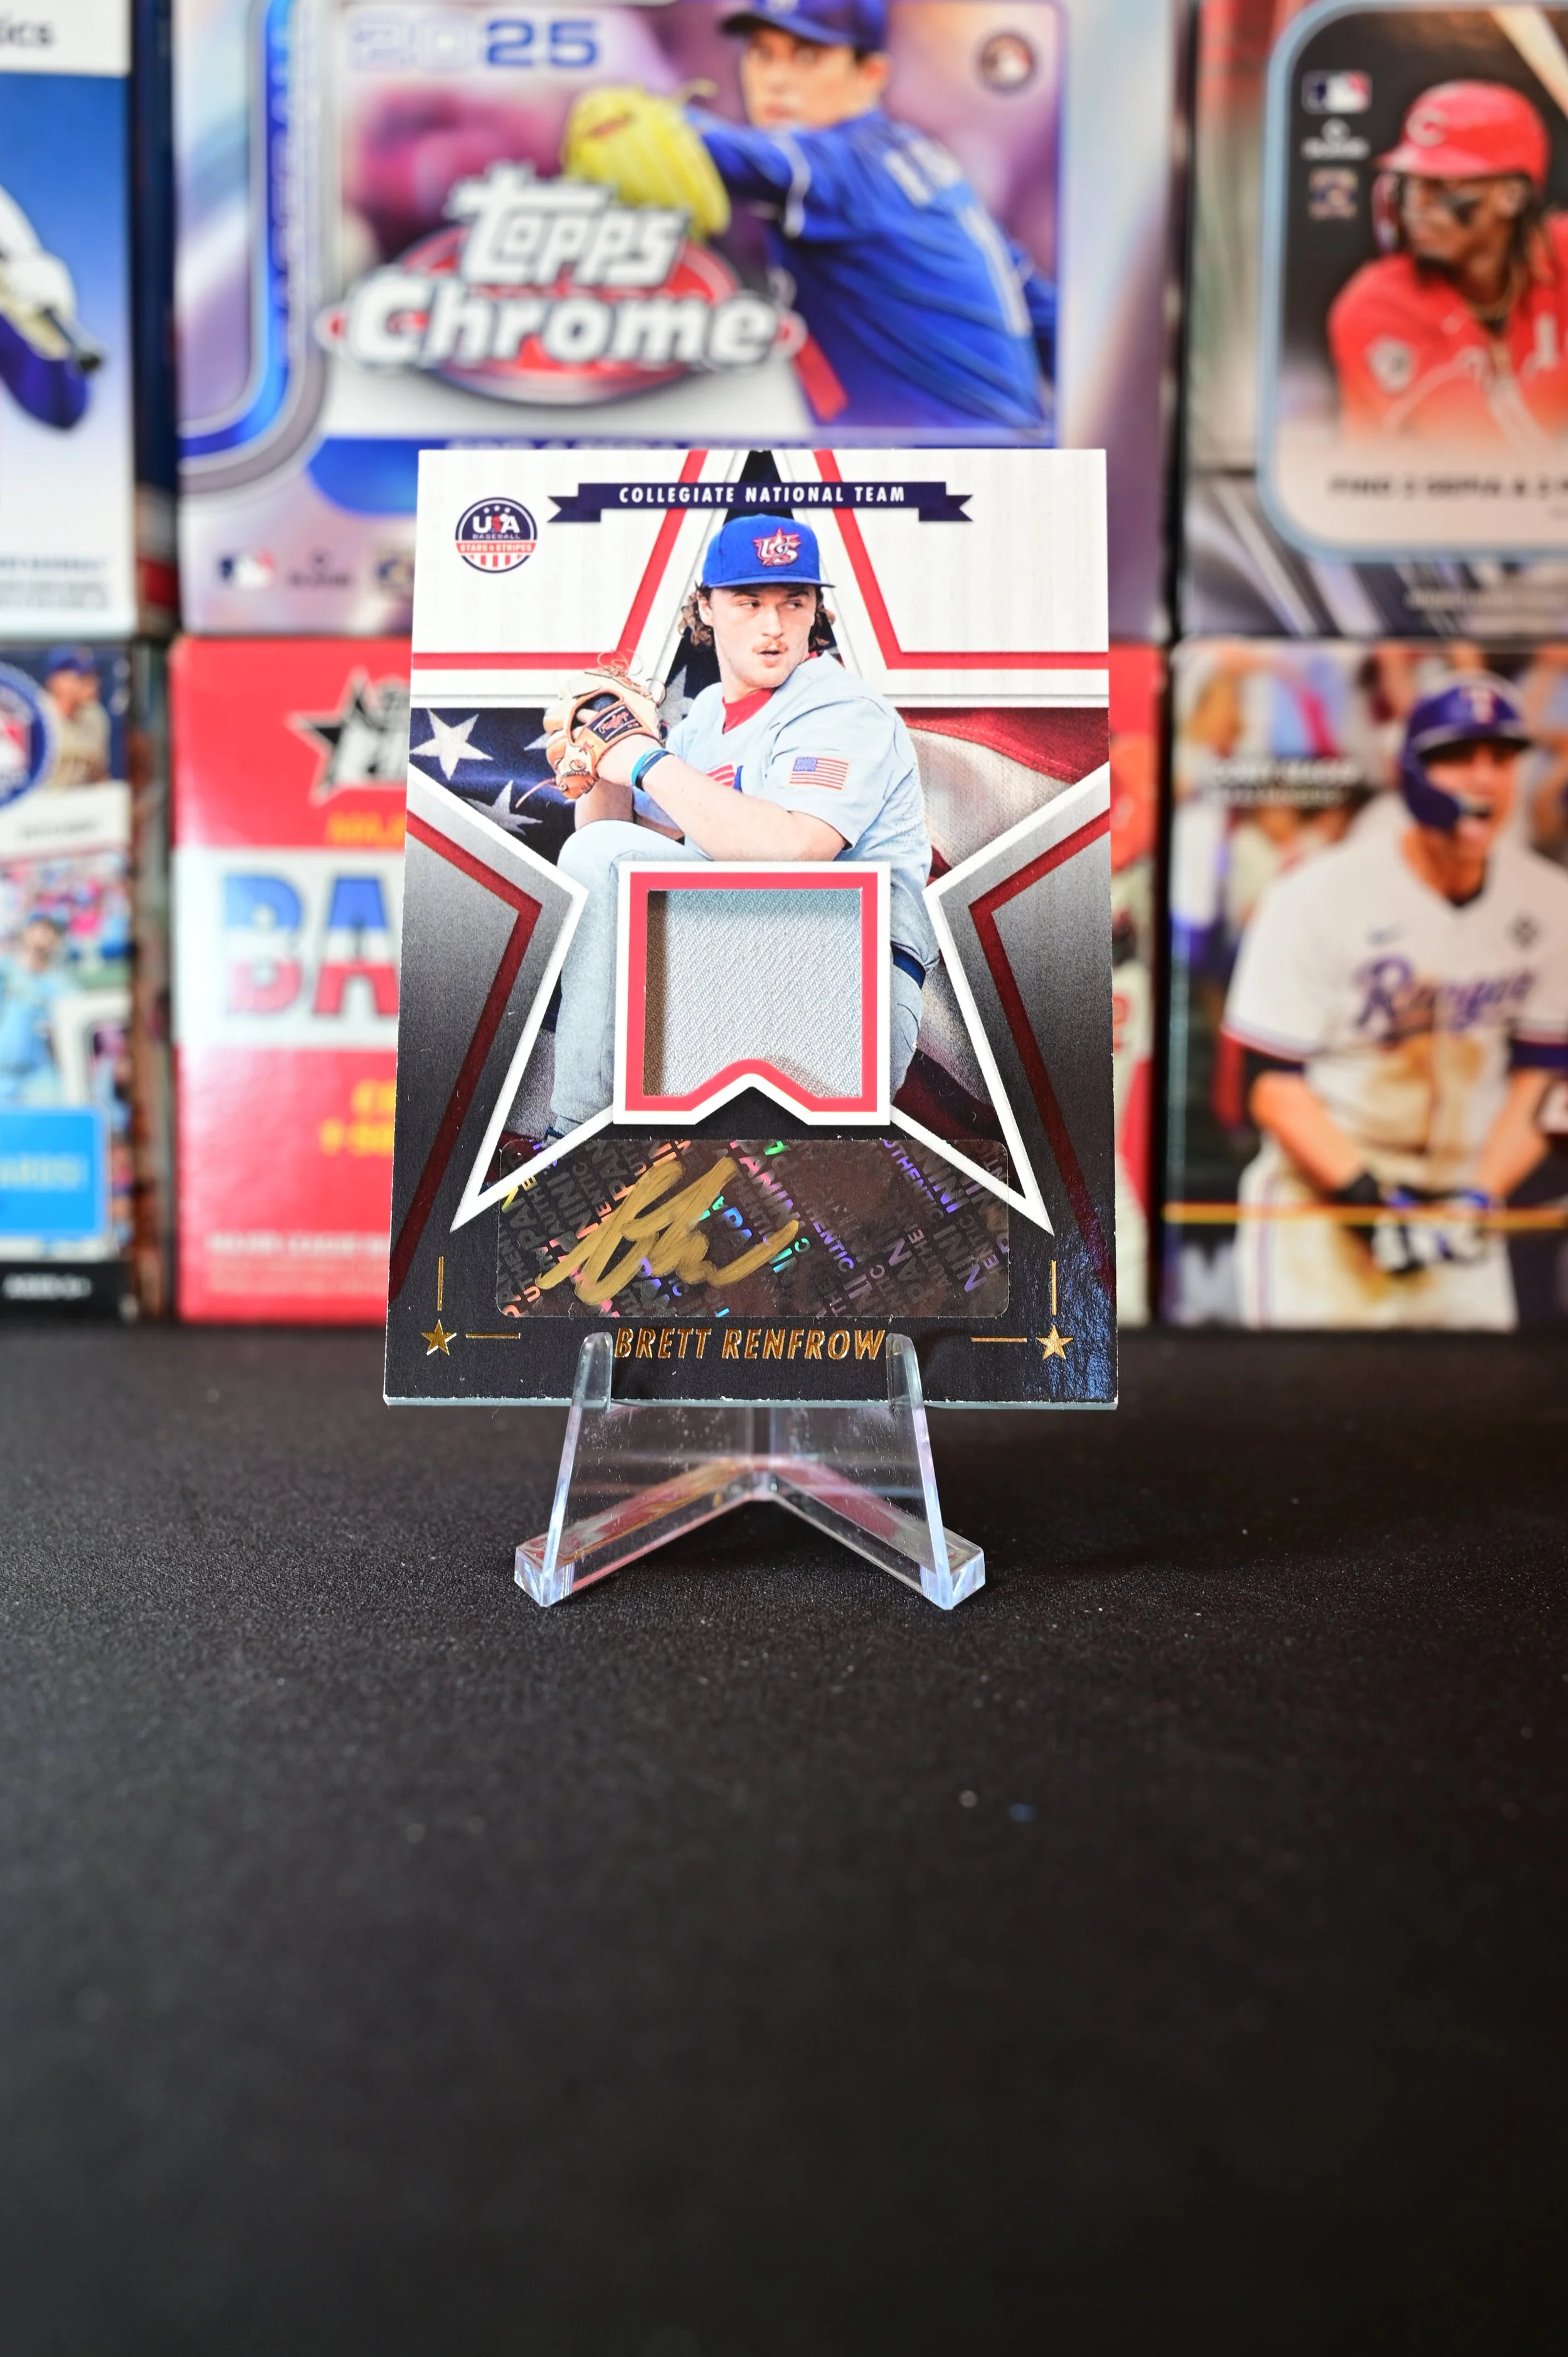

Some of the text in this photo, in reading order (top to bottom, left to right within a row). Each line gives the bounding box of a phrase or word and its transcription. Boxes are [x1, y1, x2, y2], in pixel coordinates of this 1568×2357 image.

[346, 271, 780, 365] Chrome
[619, 486, 904, 503] COLLEGIATE NATIONAL TEAM
[460, 544, 489, 552] STARS
[495, 544, 532, 552] STRIPES
[614, 1327, 886, 1360] BRETT RENFROW
